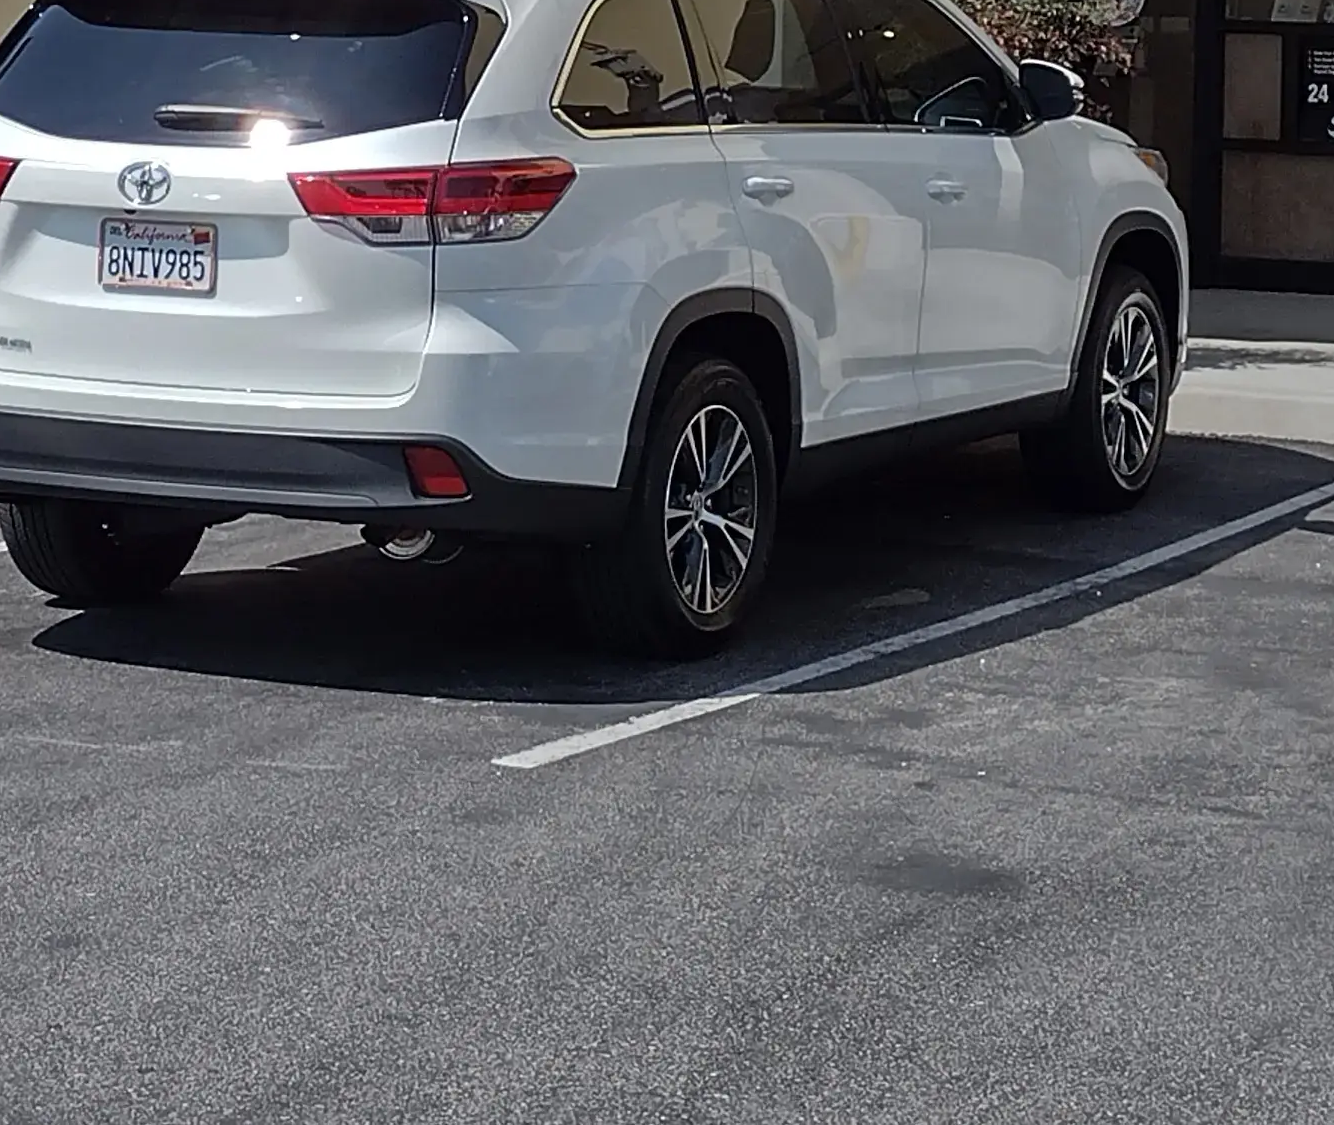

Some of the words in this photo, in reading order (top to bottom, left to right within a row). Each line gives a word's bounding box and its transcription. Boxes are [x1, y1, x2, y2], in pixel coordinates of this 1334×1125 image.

[1307, 83, 1329, 104] 24
[124, 222, 187, 246] California
[108, 245, 206, 282] 8NIV985
